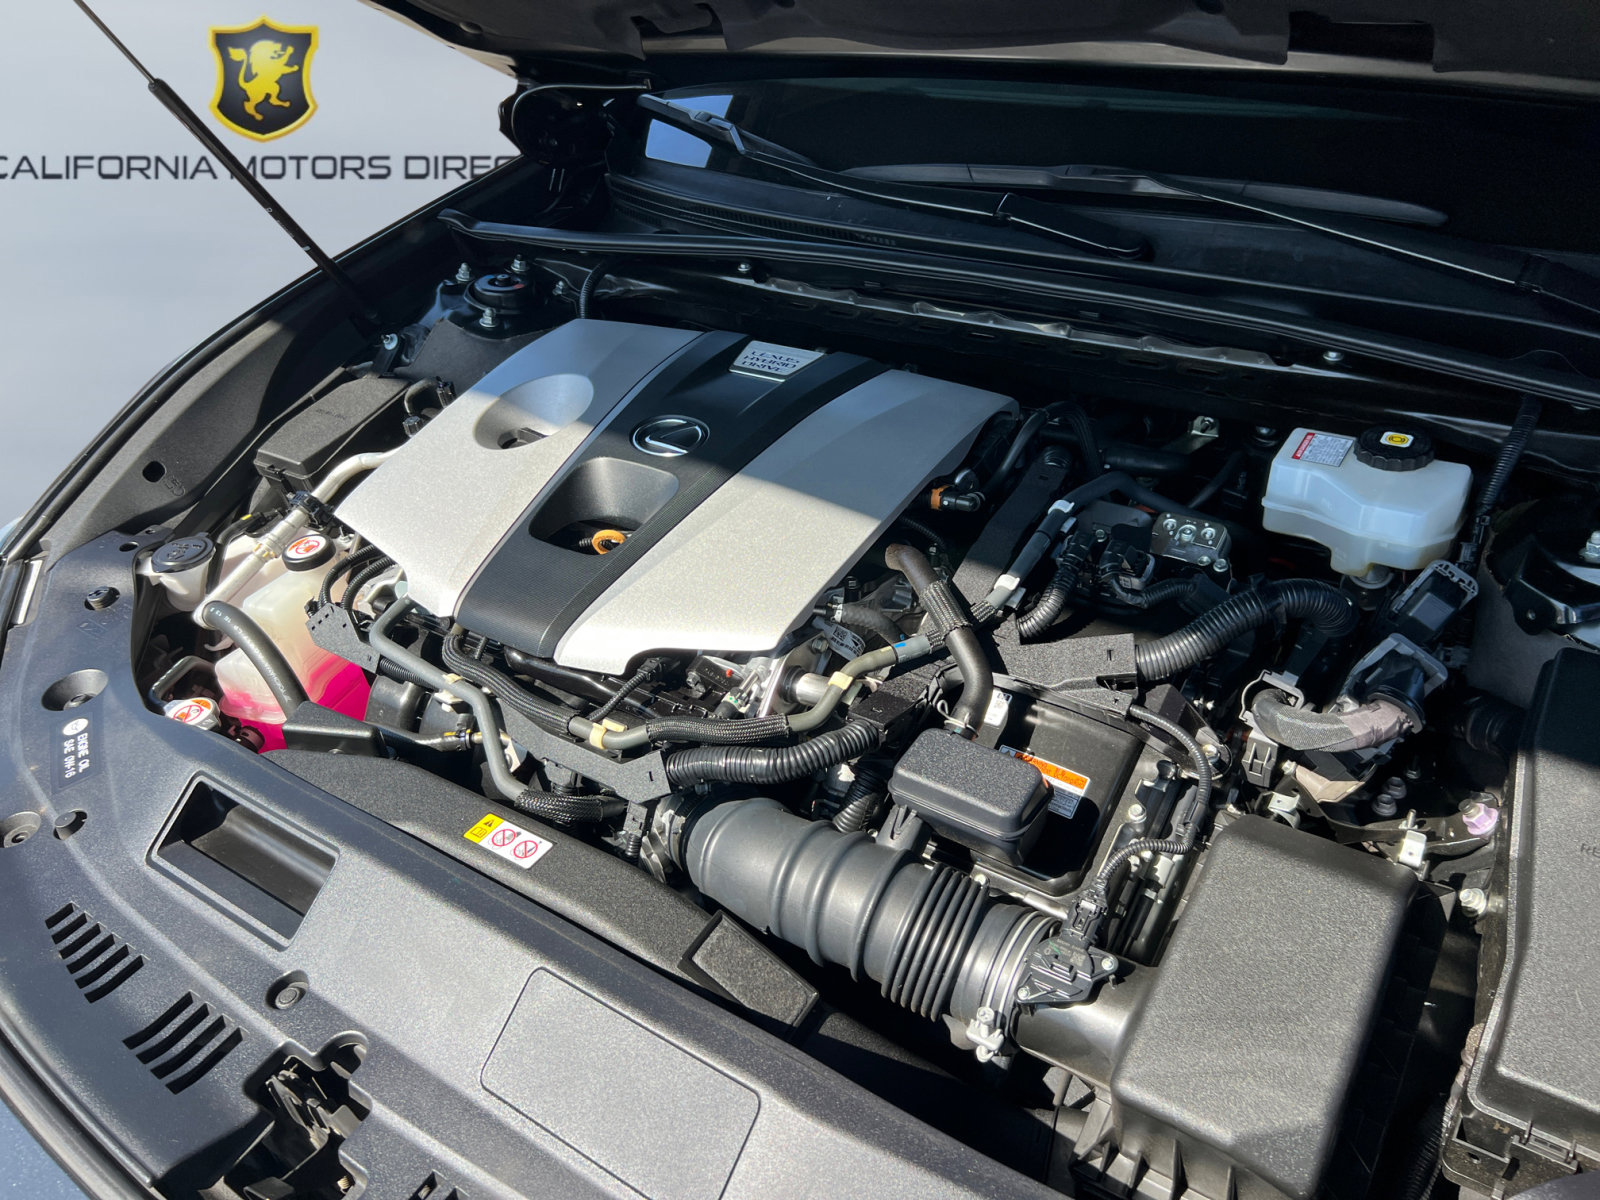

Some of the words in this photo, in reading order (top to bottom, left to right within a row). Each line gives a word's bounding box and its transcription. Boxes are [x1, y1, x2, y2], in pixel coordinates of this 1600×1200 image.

[743, 355, 797, 369] HYBRID
[751, 350, 800, 364] LEXUS
[742, 360, 780, 372] DRIVE
[63, 738, 75, 755] SAE
[77, 758, 91, 774] OIL
